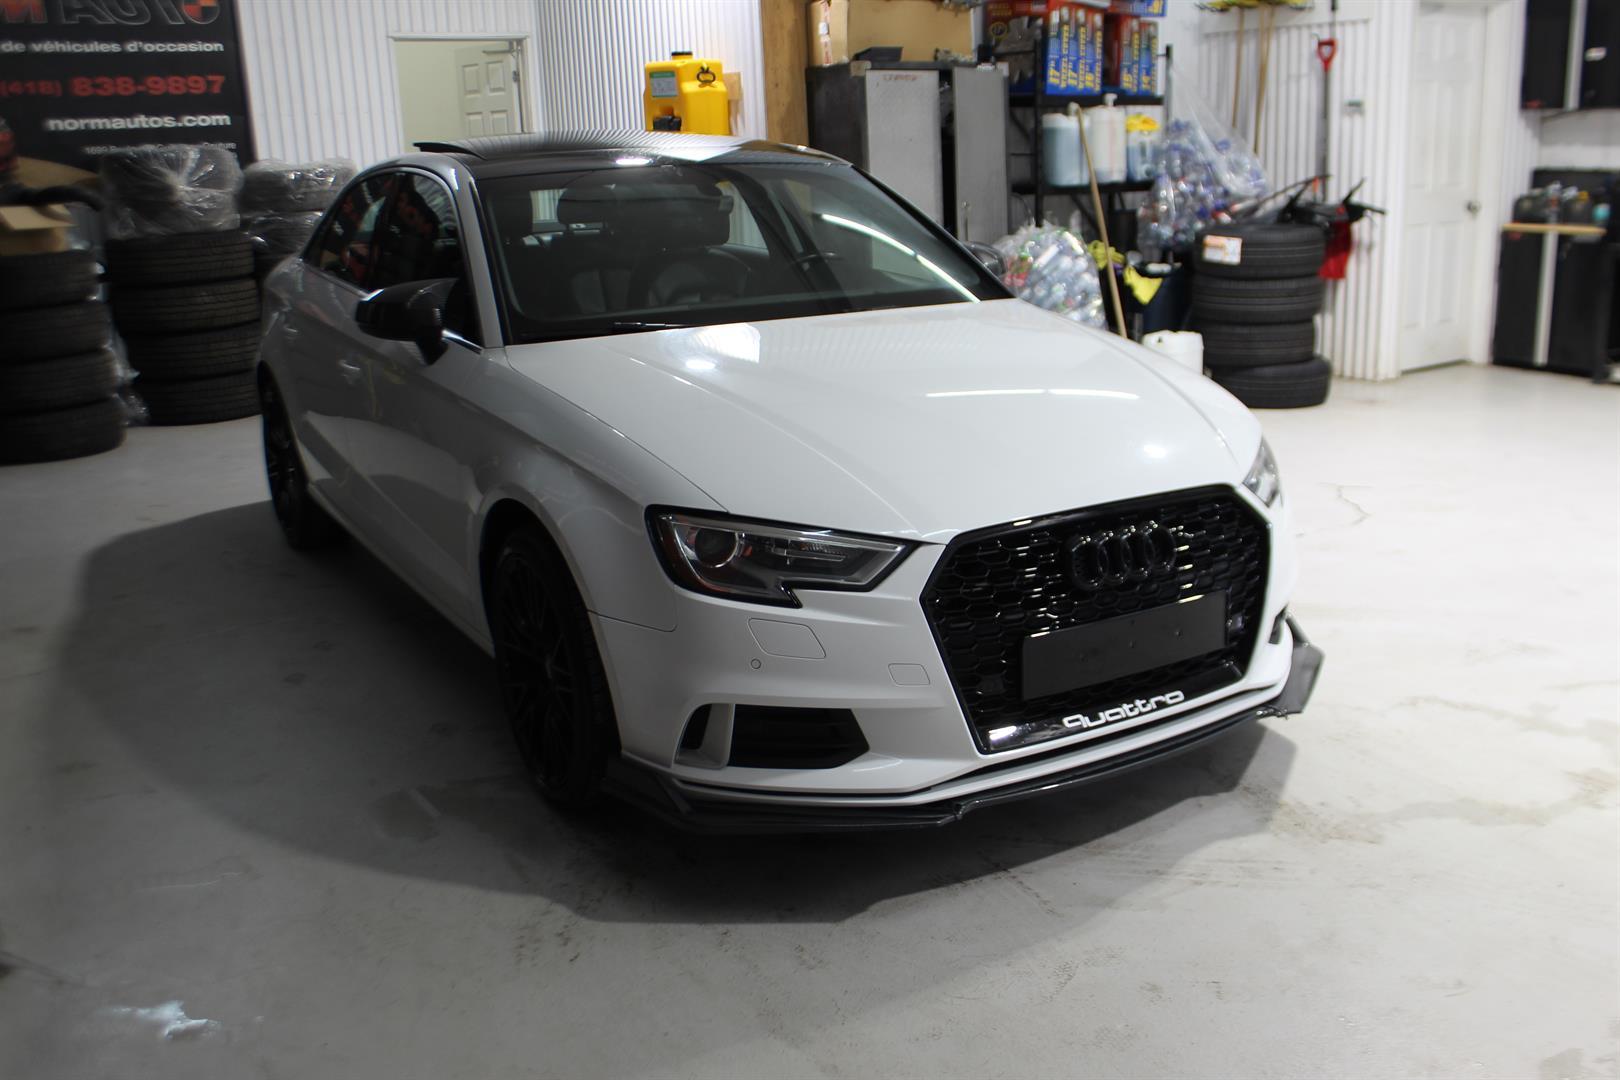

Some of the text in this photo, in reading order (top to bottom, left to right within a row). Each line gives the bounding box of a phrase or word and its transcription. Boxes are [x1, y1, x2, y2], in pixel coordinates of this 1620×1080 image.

[2, 40, 224, 52] de véhicules d'occasion
[1, 75, 225, 96] (418) 838-9897
[48, 114, 231, 131] normautos.com
[1062, 690, 1184, 728] quattro
